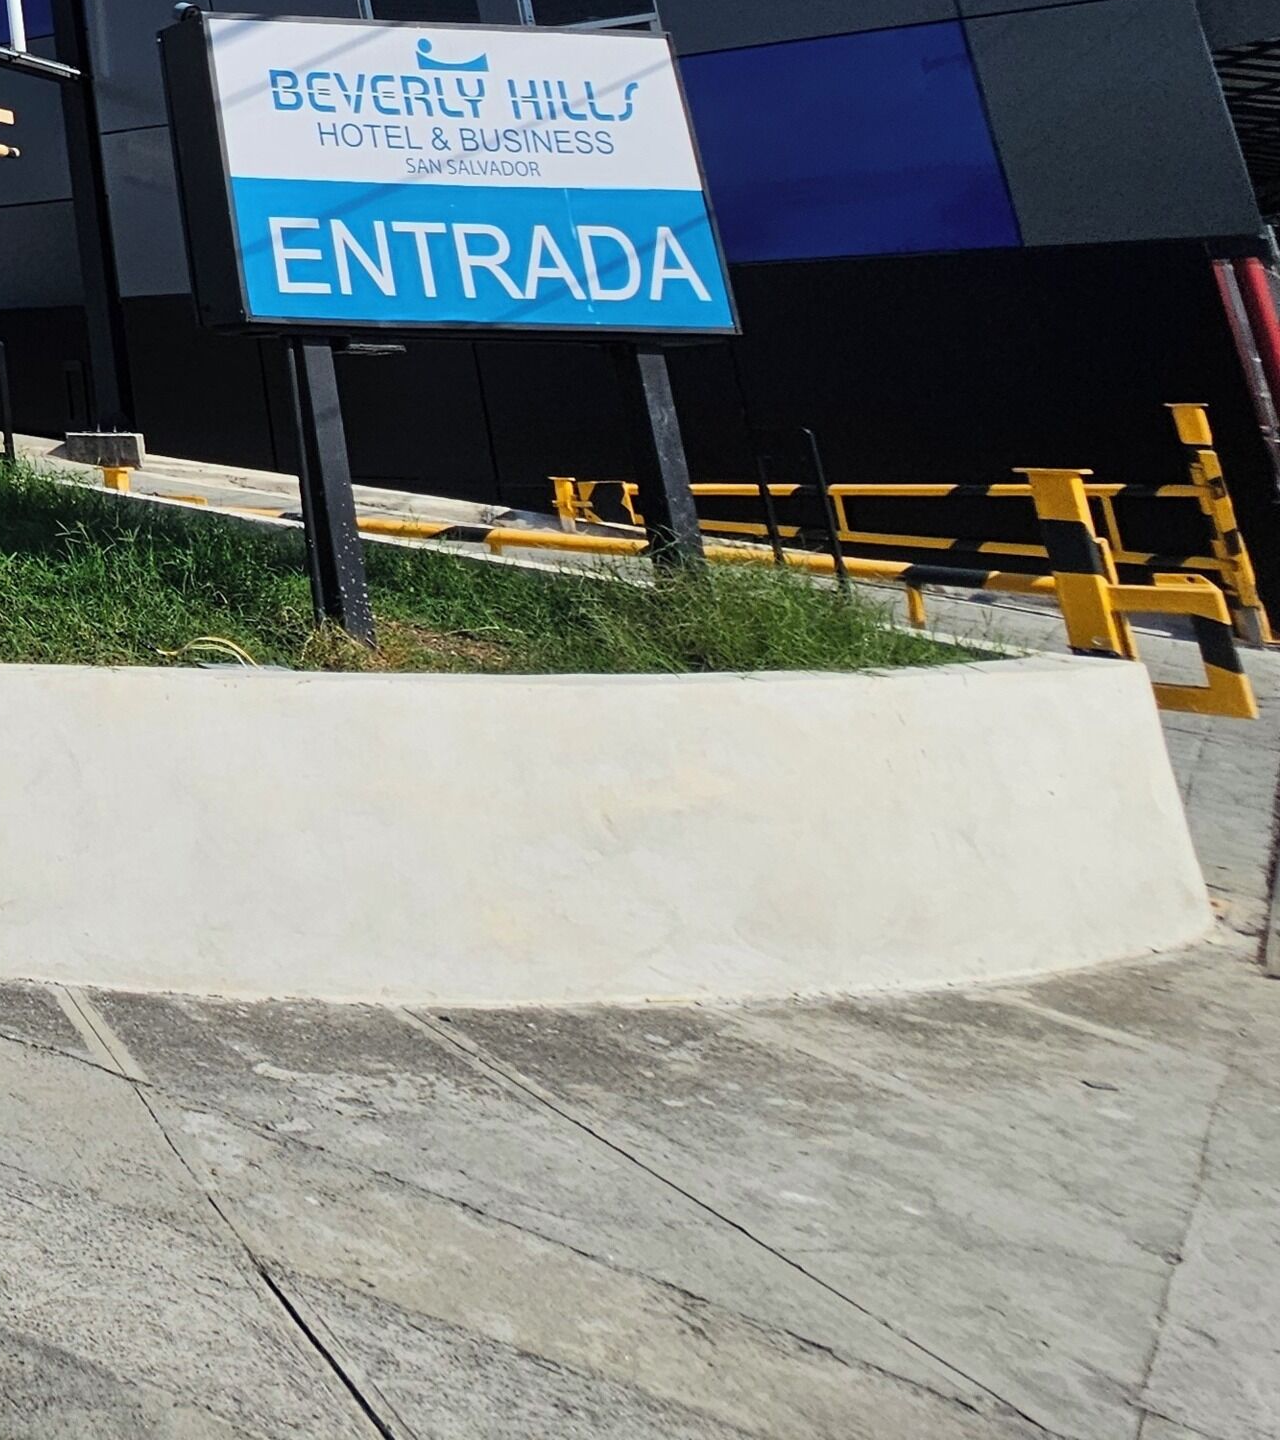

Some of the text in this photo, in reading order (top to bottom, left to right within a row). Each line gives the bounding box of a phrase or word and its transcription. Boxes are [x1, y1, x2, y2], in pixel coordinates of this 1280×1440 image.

[269, 69, 639, 122] BEVERLY HILLS
[317, 122, 614, 156] HOTEL & BUSINESS
[406, 157, 541, 177] SAN SALVADOR
[268, 216, 712, 302] ENTRADA
